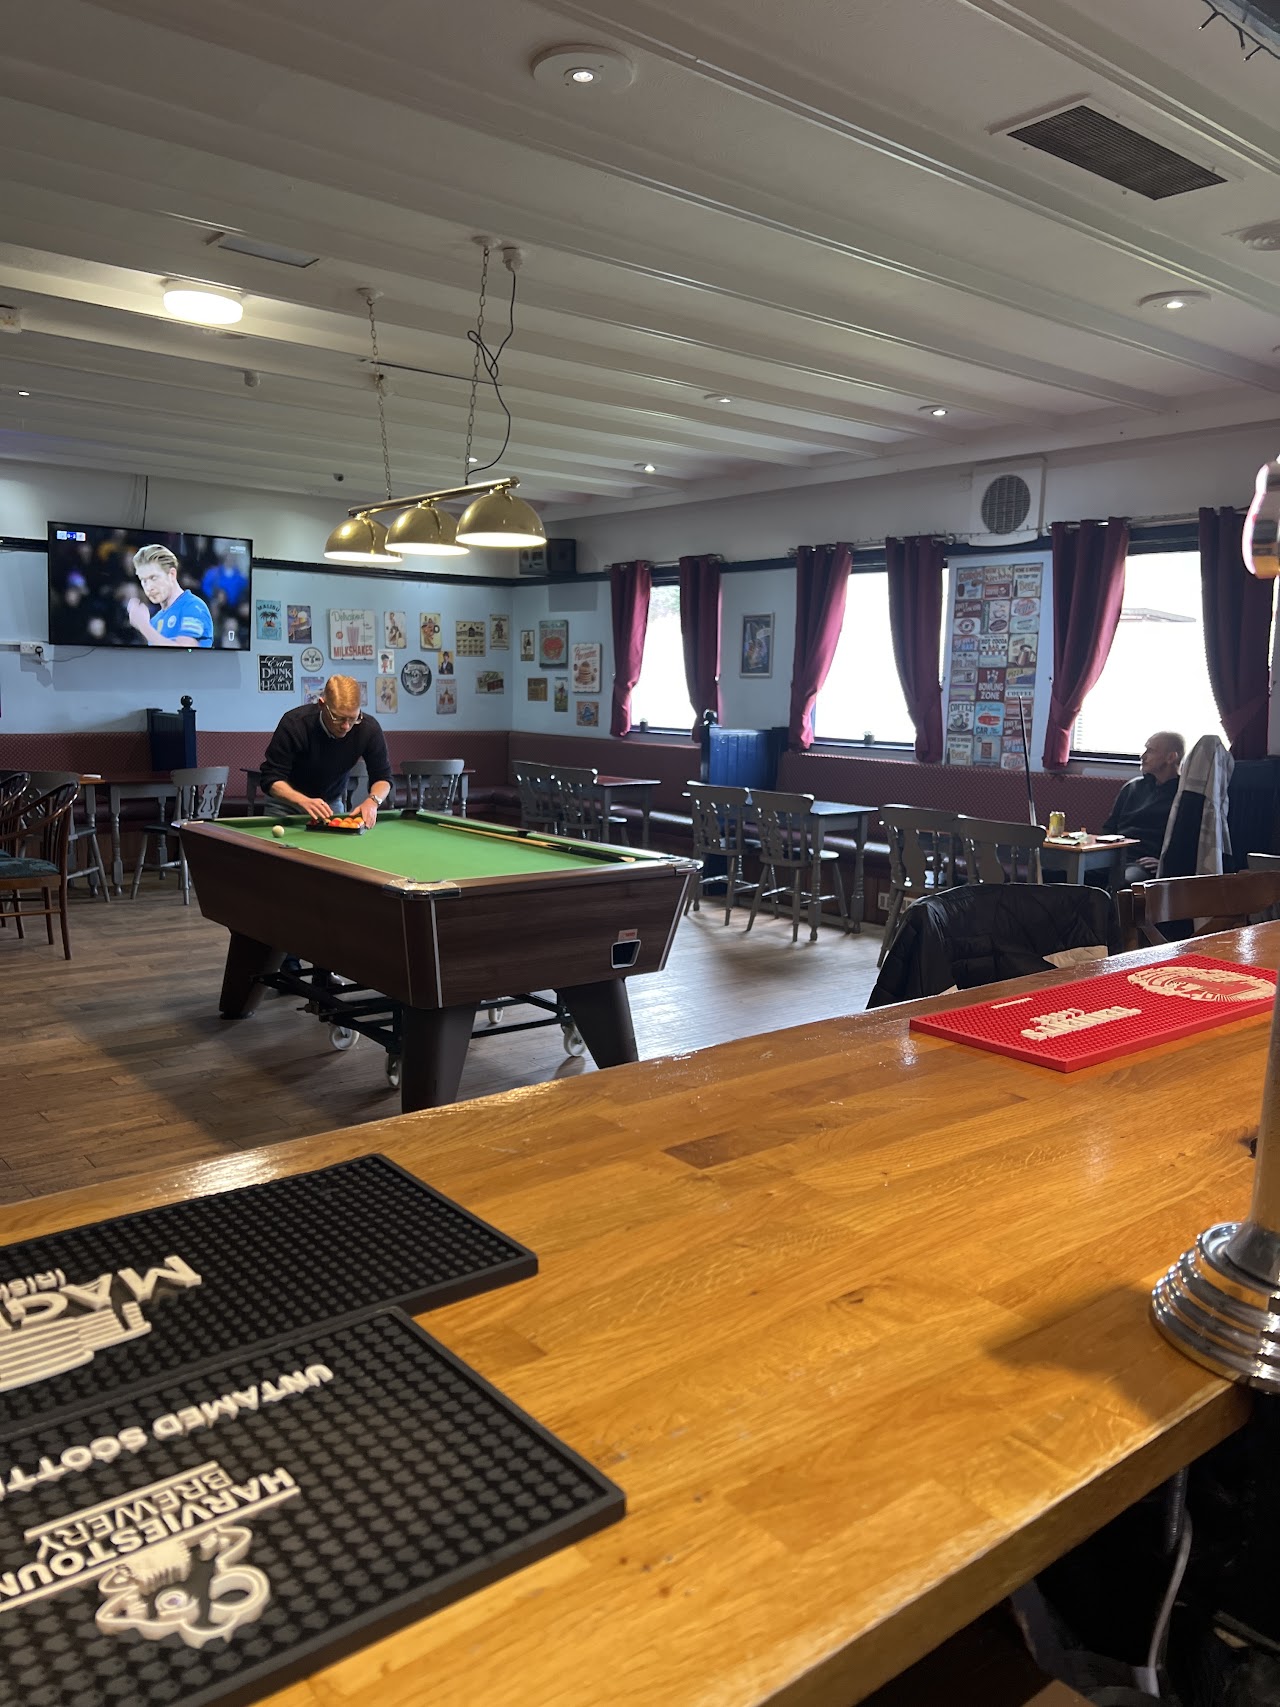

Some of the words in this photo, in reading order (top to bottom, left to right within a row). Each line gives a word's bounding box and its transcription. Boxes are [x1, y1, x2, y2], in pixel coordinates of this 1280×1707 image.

[257, 604, 280, 612] MALIBU
[333, 644, 374, 658] MILKSHAKES
[266, 656, 286, 667] Eat
[262, 666, 292, 679] DRINK
[261, 680, 292, 691] HAPPY
[978, 682, 1004, 692] BOWLING
[980, 691, 1000, 700] ZONE
[950, 703, 974, 712] COFFEE
[976, 727, 988, 735] CAR
[153, 1364, 334, 1440] UNTAMED
[0, 1426, 148, 1500] SCOTT
[36, 1469, 233, 1566] BREWERY
